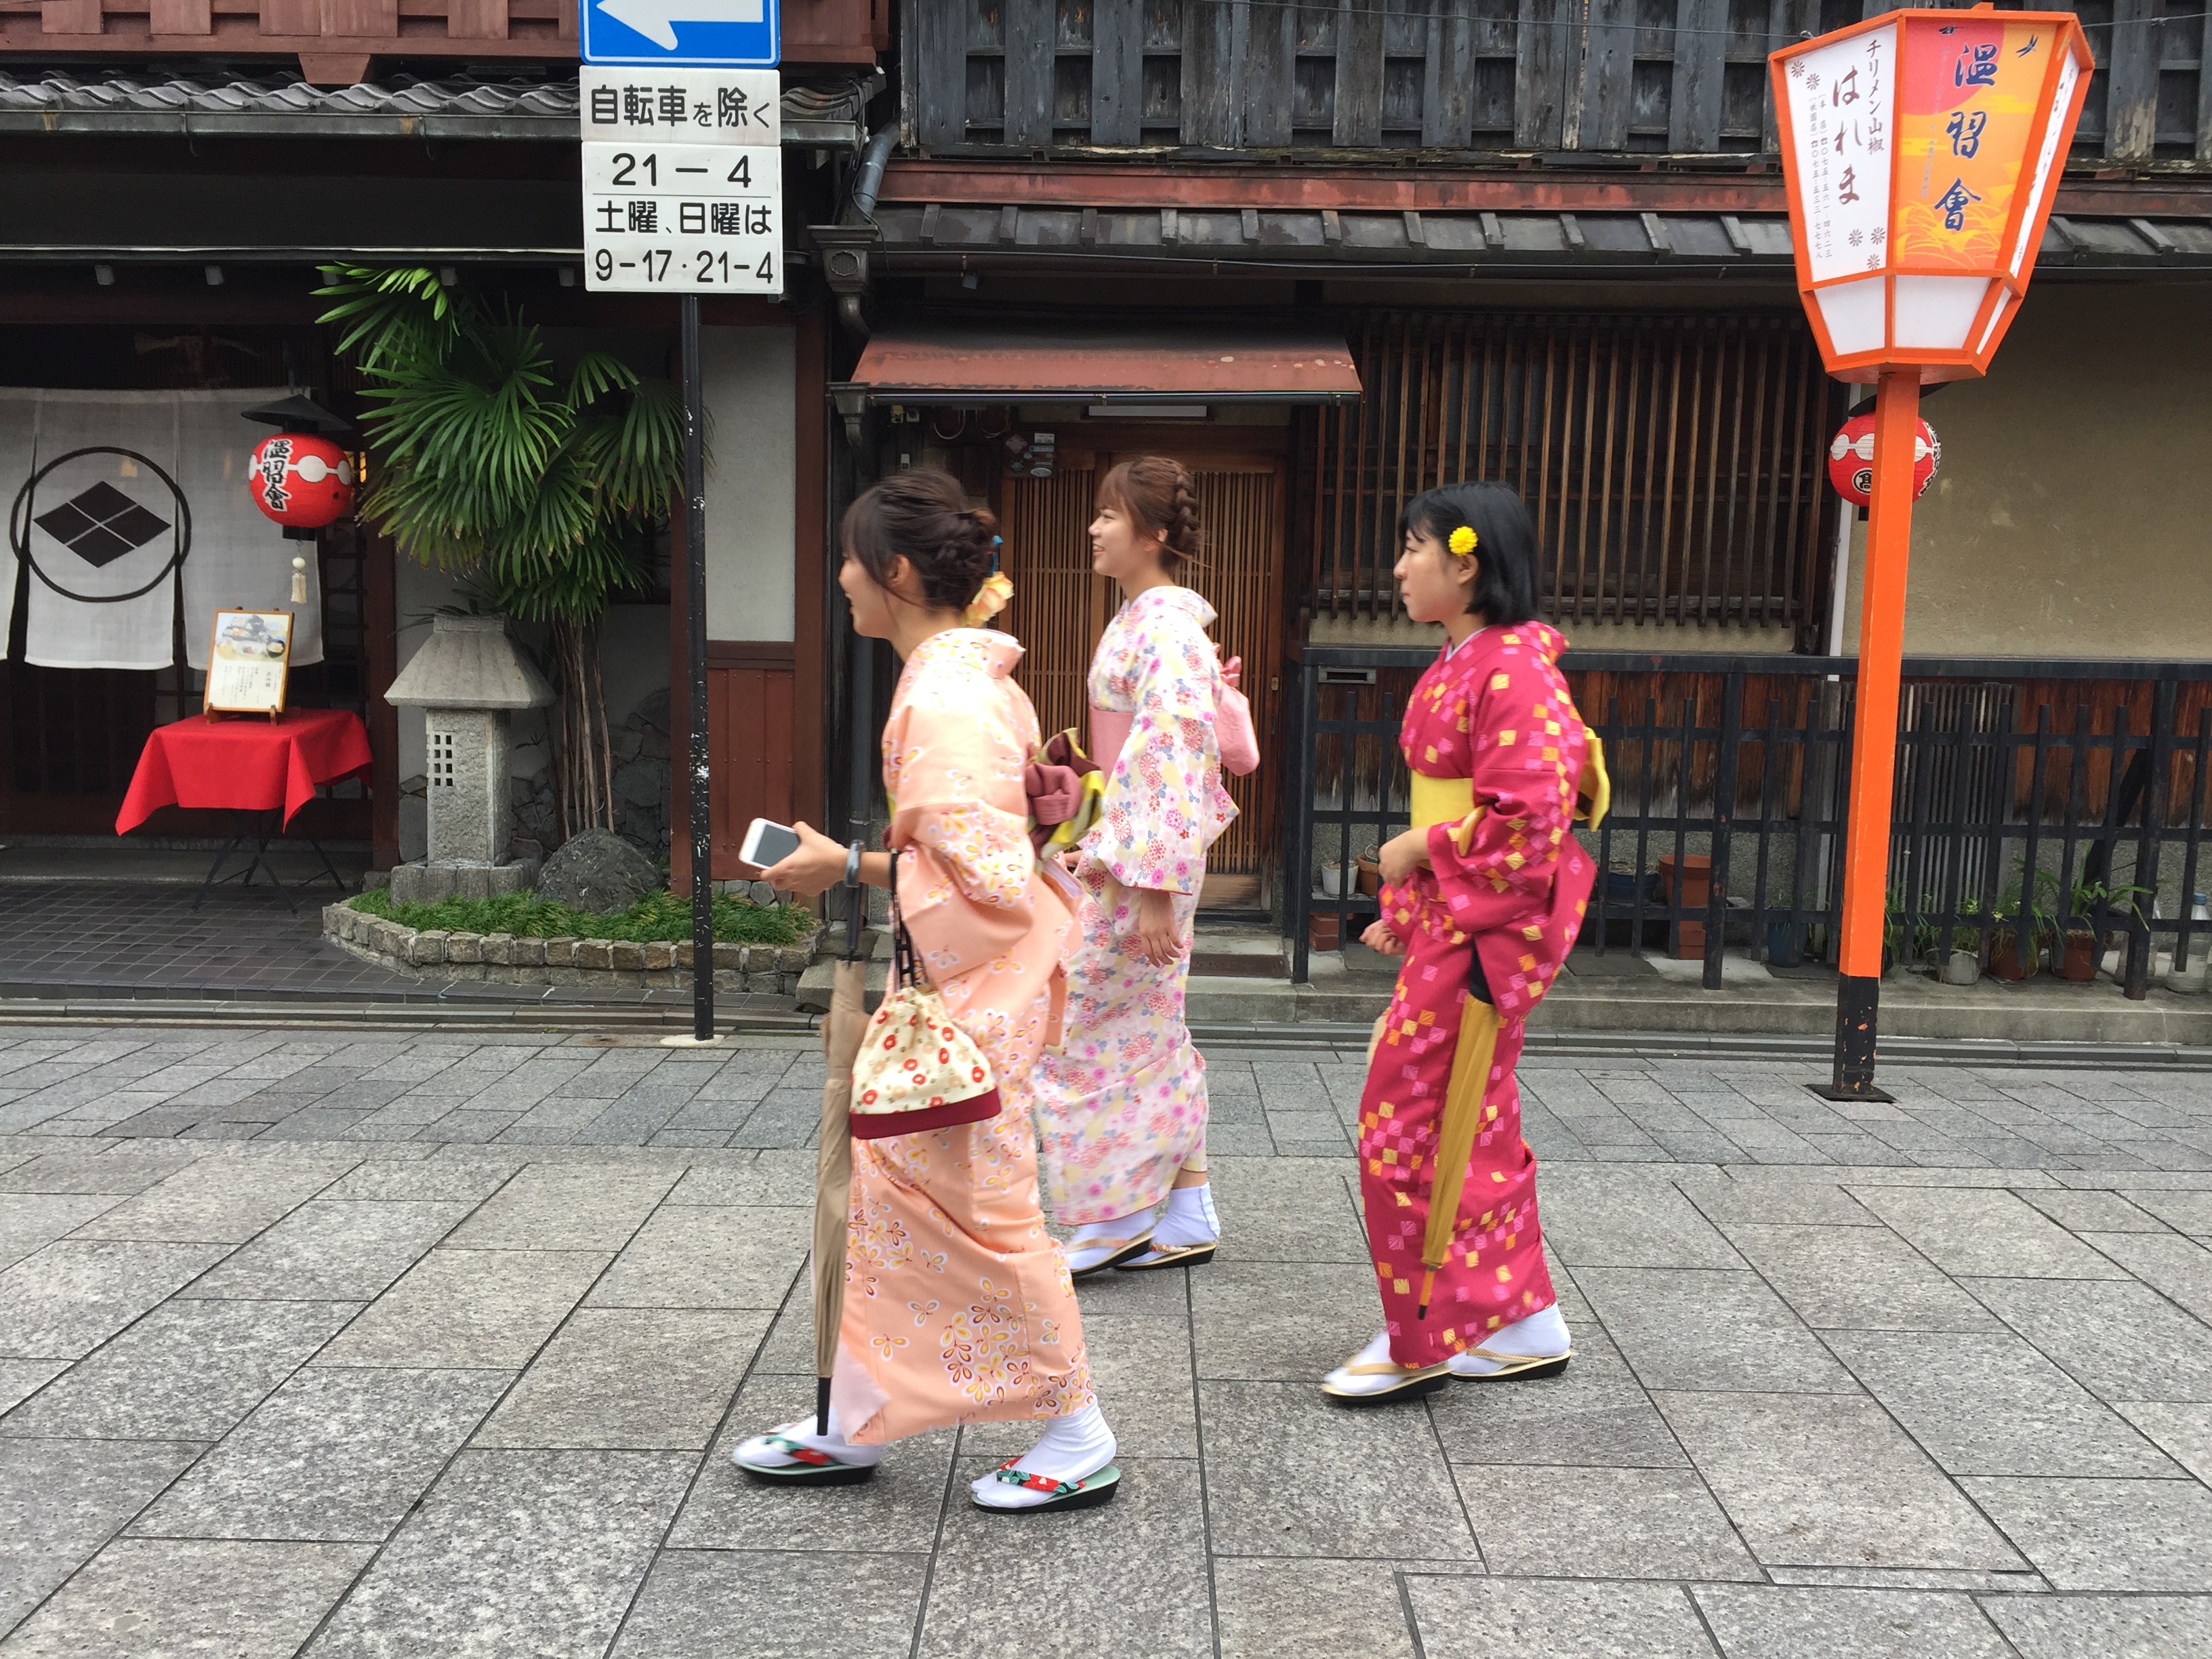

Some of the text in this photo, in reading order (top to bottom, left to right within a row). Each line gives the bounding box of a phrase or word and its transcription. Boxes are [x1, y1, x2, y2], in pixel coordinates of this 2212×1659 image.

[591, 84, 770, 128] 自転車を除く
[1832, 65, 1862, 205] はれま
[1866, 39, 1885, 155] チリメン山椒
[596, 200, 773, 235] 土曜、日曜は
